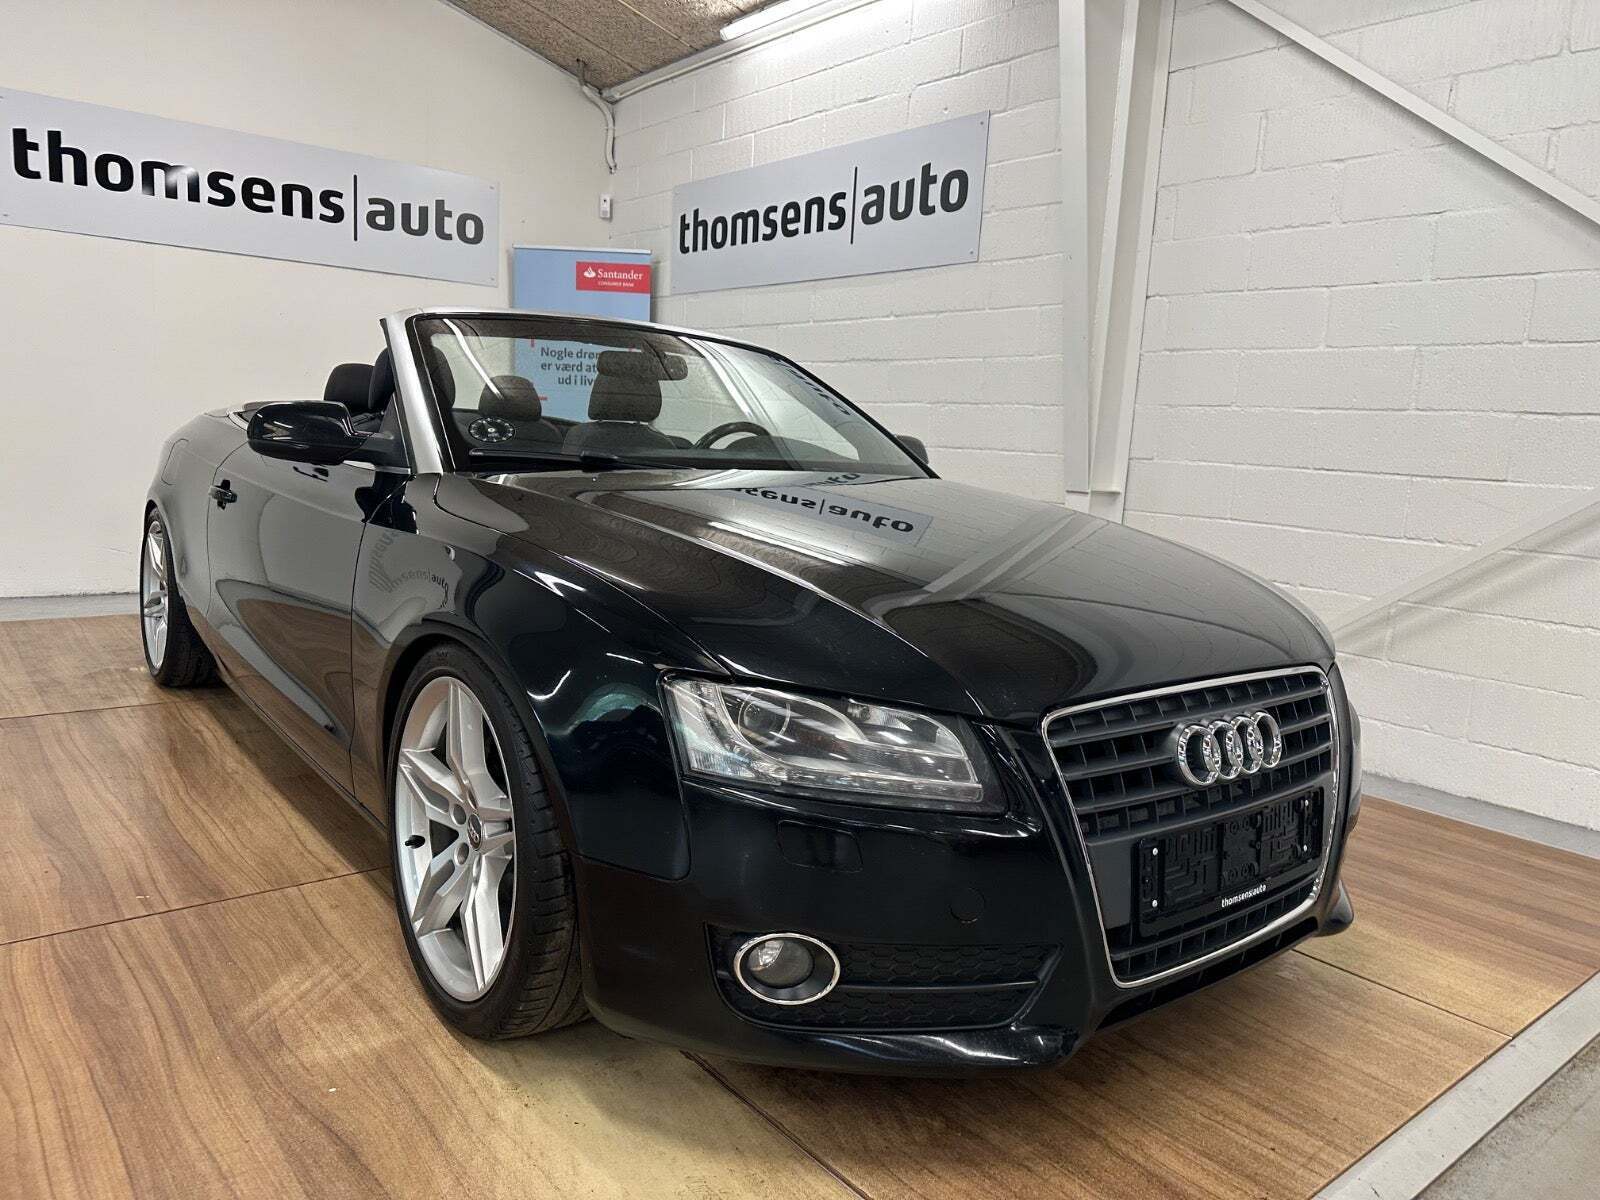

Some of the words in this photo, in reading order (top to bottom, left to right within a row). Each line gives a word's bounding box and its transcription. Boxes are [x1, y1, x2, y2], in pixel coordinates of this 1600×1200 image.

[597, 269, 643, 281] Santander
[540, 347, 573, 360] Nogle
[541, 362, 552, 371] er
[555, 361, 582, 372] værd
[585, 364, 597, 373] at
[558, 375, 571, 385] ud
